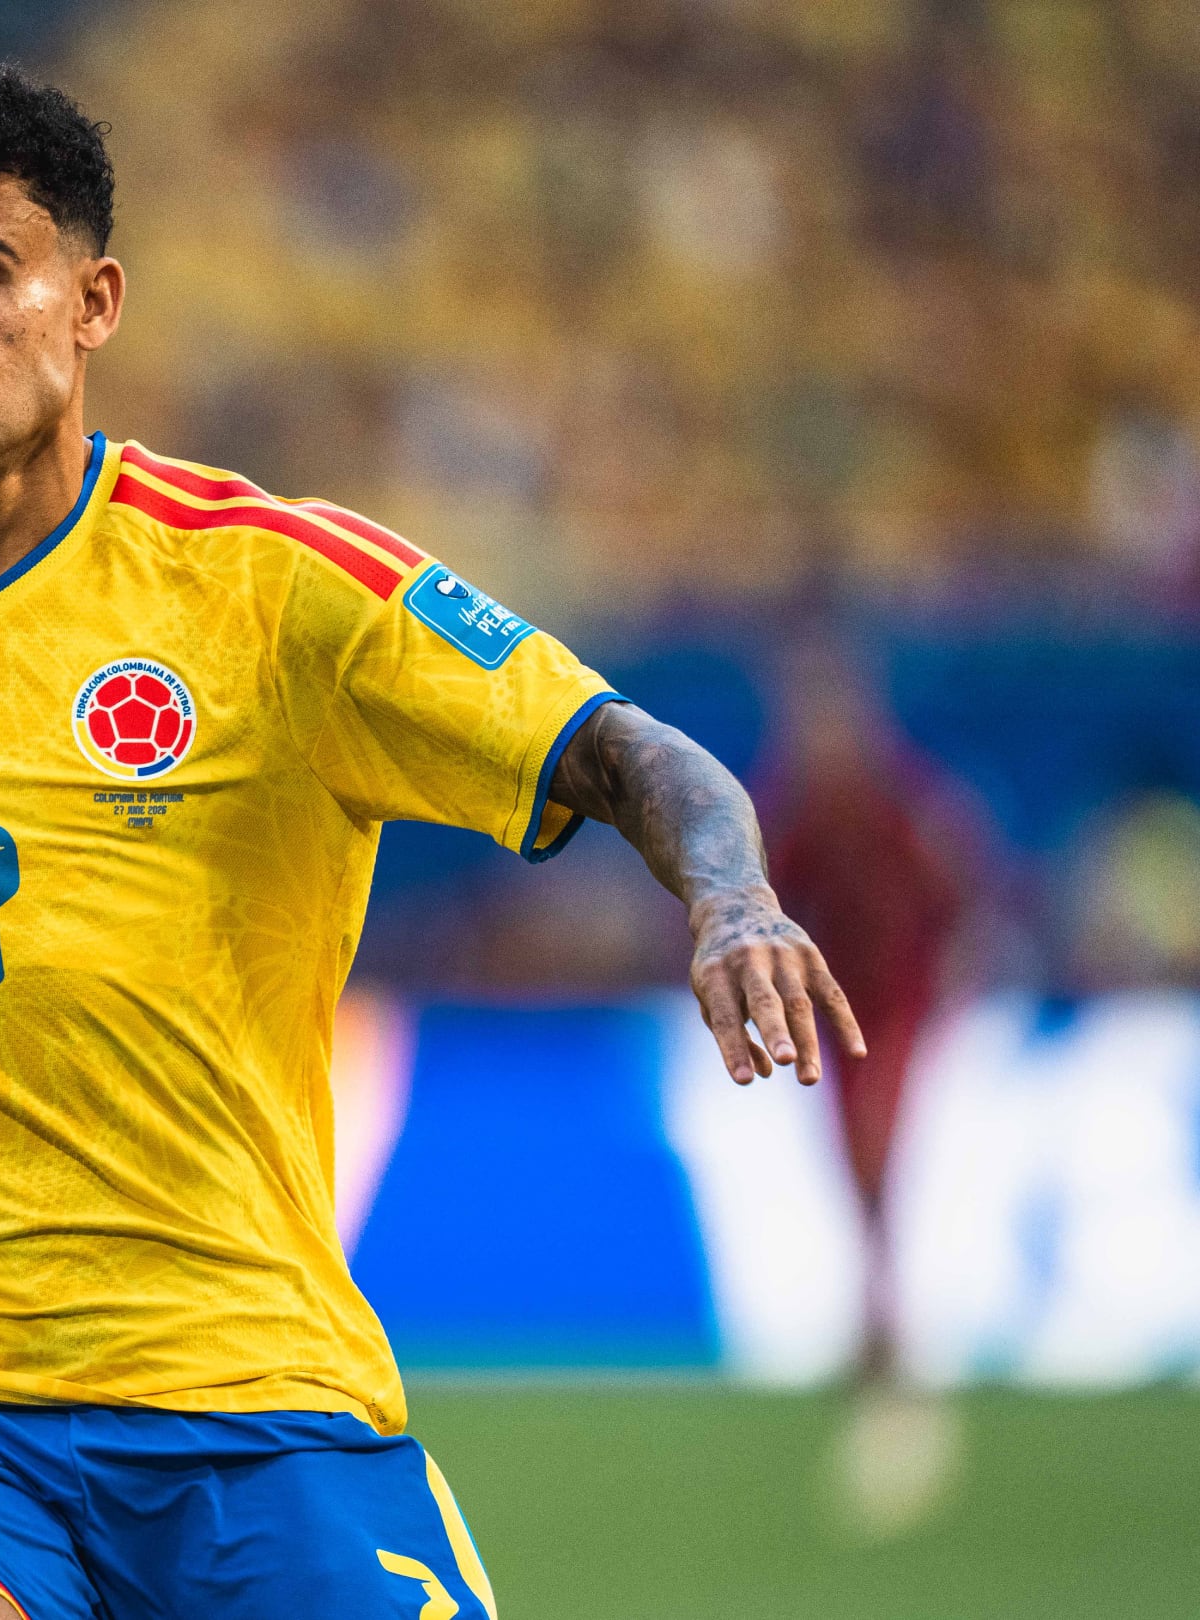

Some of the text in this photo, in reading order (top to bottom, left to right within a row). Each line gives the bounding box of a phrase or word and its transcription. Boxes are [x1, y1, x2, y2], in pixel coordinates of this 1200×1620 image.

[76, 671, 108, 719] FEDERACIÓN
[107, 662, 165, 679] COLOMBIANA
[164, 674, 176, 687] DE
[114, 806, 124, 815] 27
[147, 806, 167, 815] 2026
